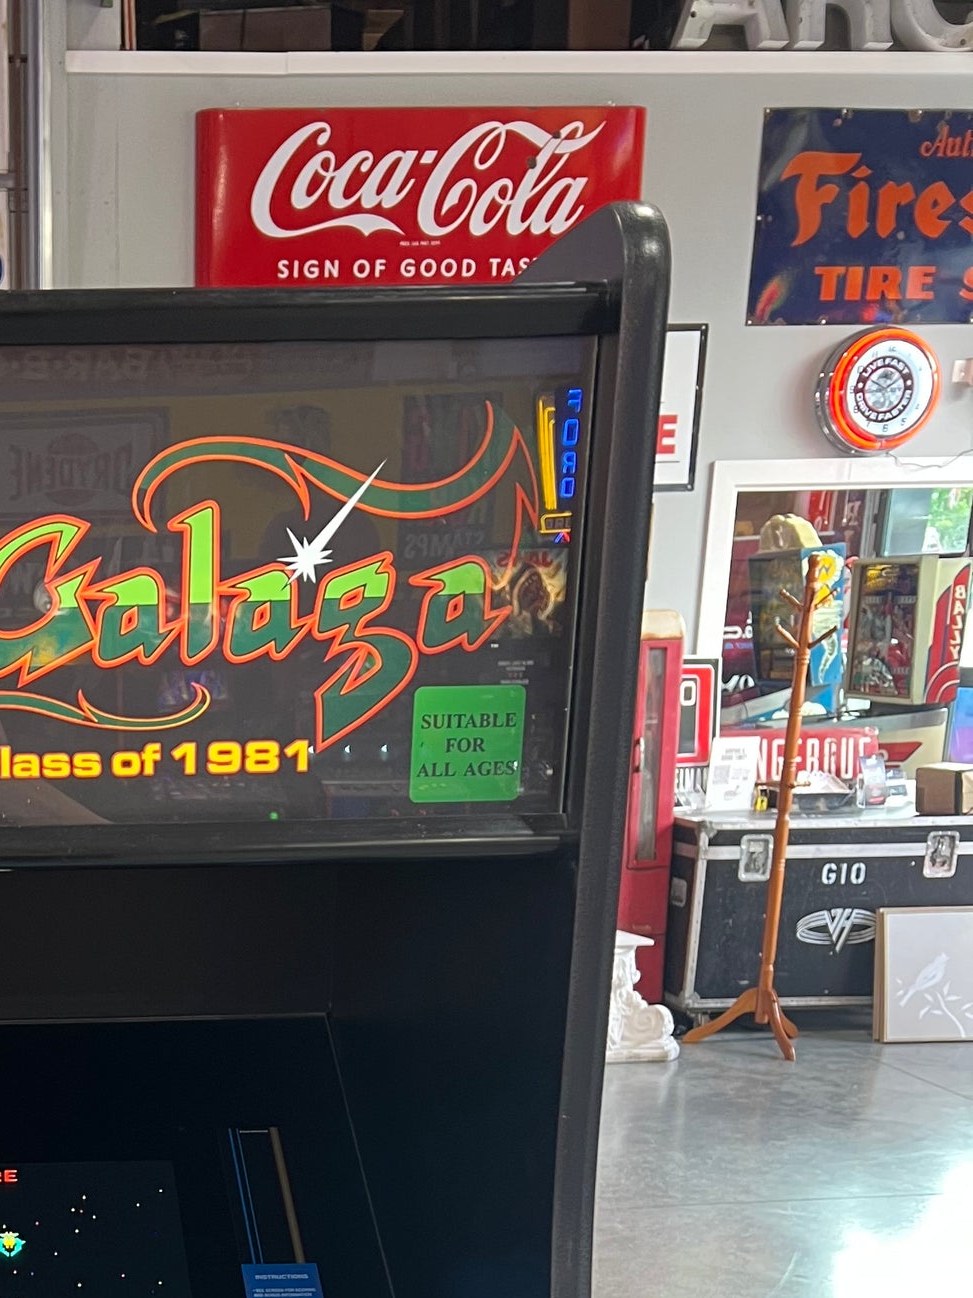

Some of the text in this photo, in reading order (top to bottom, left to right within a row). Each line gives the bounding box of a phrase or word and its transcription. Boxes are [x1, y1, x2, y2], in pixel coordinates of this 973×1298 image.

[251, 121, 607, 238] Coca-Cola
[277, 259, 339, 279] SIGN
[353, 259, 387, 278] OF
[400, 258, 476, 277] GOOD
[815, 266, 937, 301] TIRE
[862, 357, 910, 377] LIVE FAST
[856, 390, 913, 420] DRIVE FASTER
[420, 712, 517, 730] SUITABLE
[445, 737, 486, 753] FOR
[111, 742, 161, 776] of
[170, 739, 311, 774] 1981
[417, 761, 516, 778] ALL AGES
